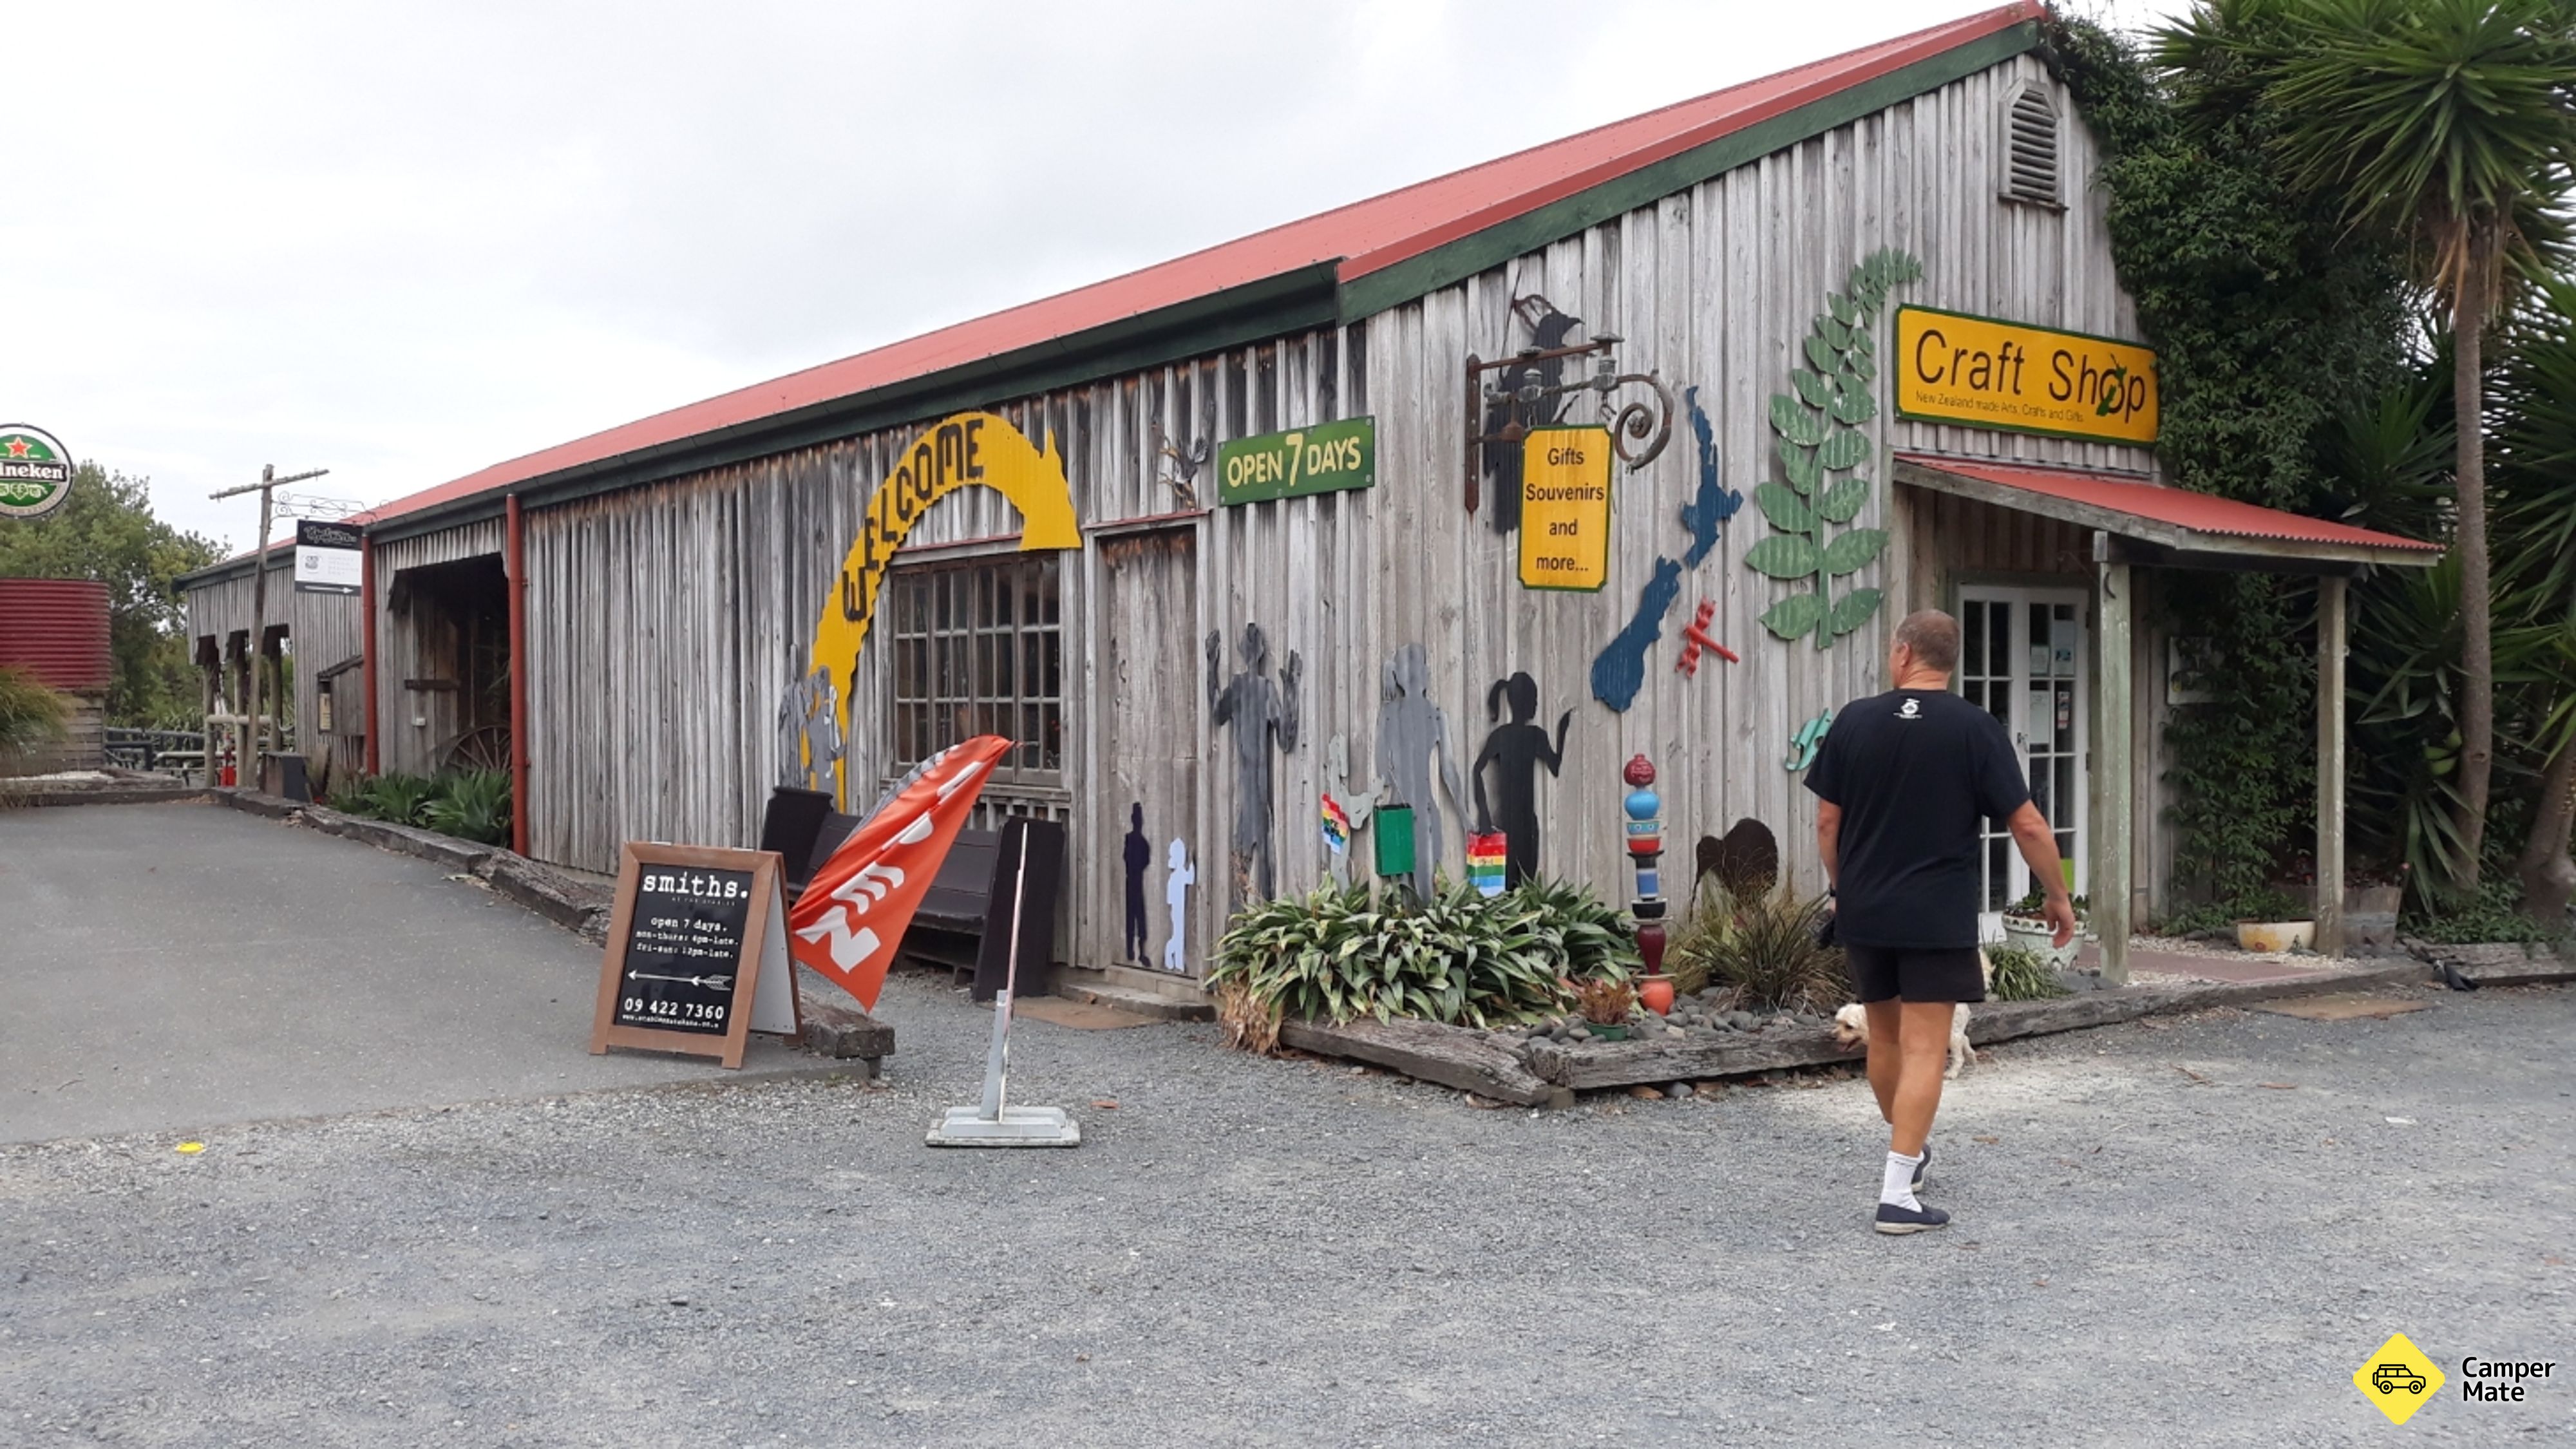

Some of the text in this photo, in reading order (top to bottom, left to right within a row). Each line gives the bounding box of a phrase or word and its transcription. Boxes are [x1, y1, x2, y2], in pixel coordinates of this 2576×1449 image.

[1916, 329, 2146, 424] Craft Shop
[1915, 390, 1935, 404] New
[1937, 393, 1974, 409] Zealand
[1975, 399, 2000, 412] made
[2022, 404, 2047, 419] Crafts
[2048, 408, 2065, 421] and
[2066, 410, 2084, 422] Gifts
[1227, 432, 1362, 488] OPEN 7 DAYS
[1547, 448, 1584, 466] Gifts
[1526, 482, 1605, 501] Souvenirs
[842, 419, 984, 622] WELCOME
[1549, 518, 1578, 536] and
[1536, 556, 1589, 571] more...
[642, 871, 748, 898] smiths.
[650, 917, 728, 933] open 7 days.
[624, 998, 724, 1020] 09 422 7360
